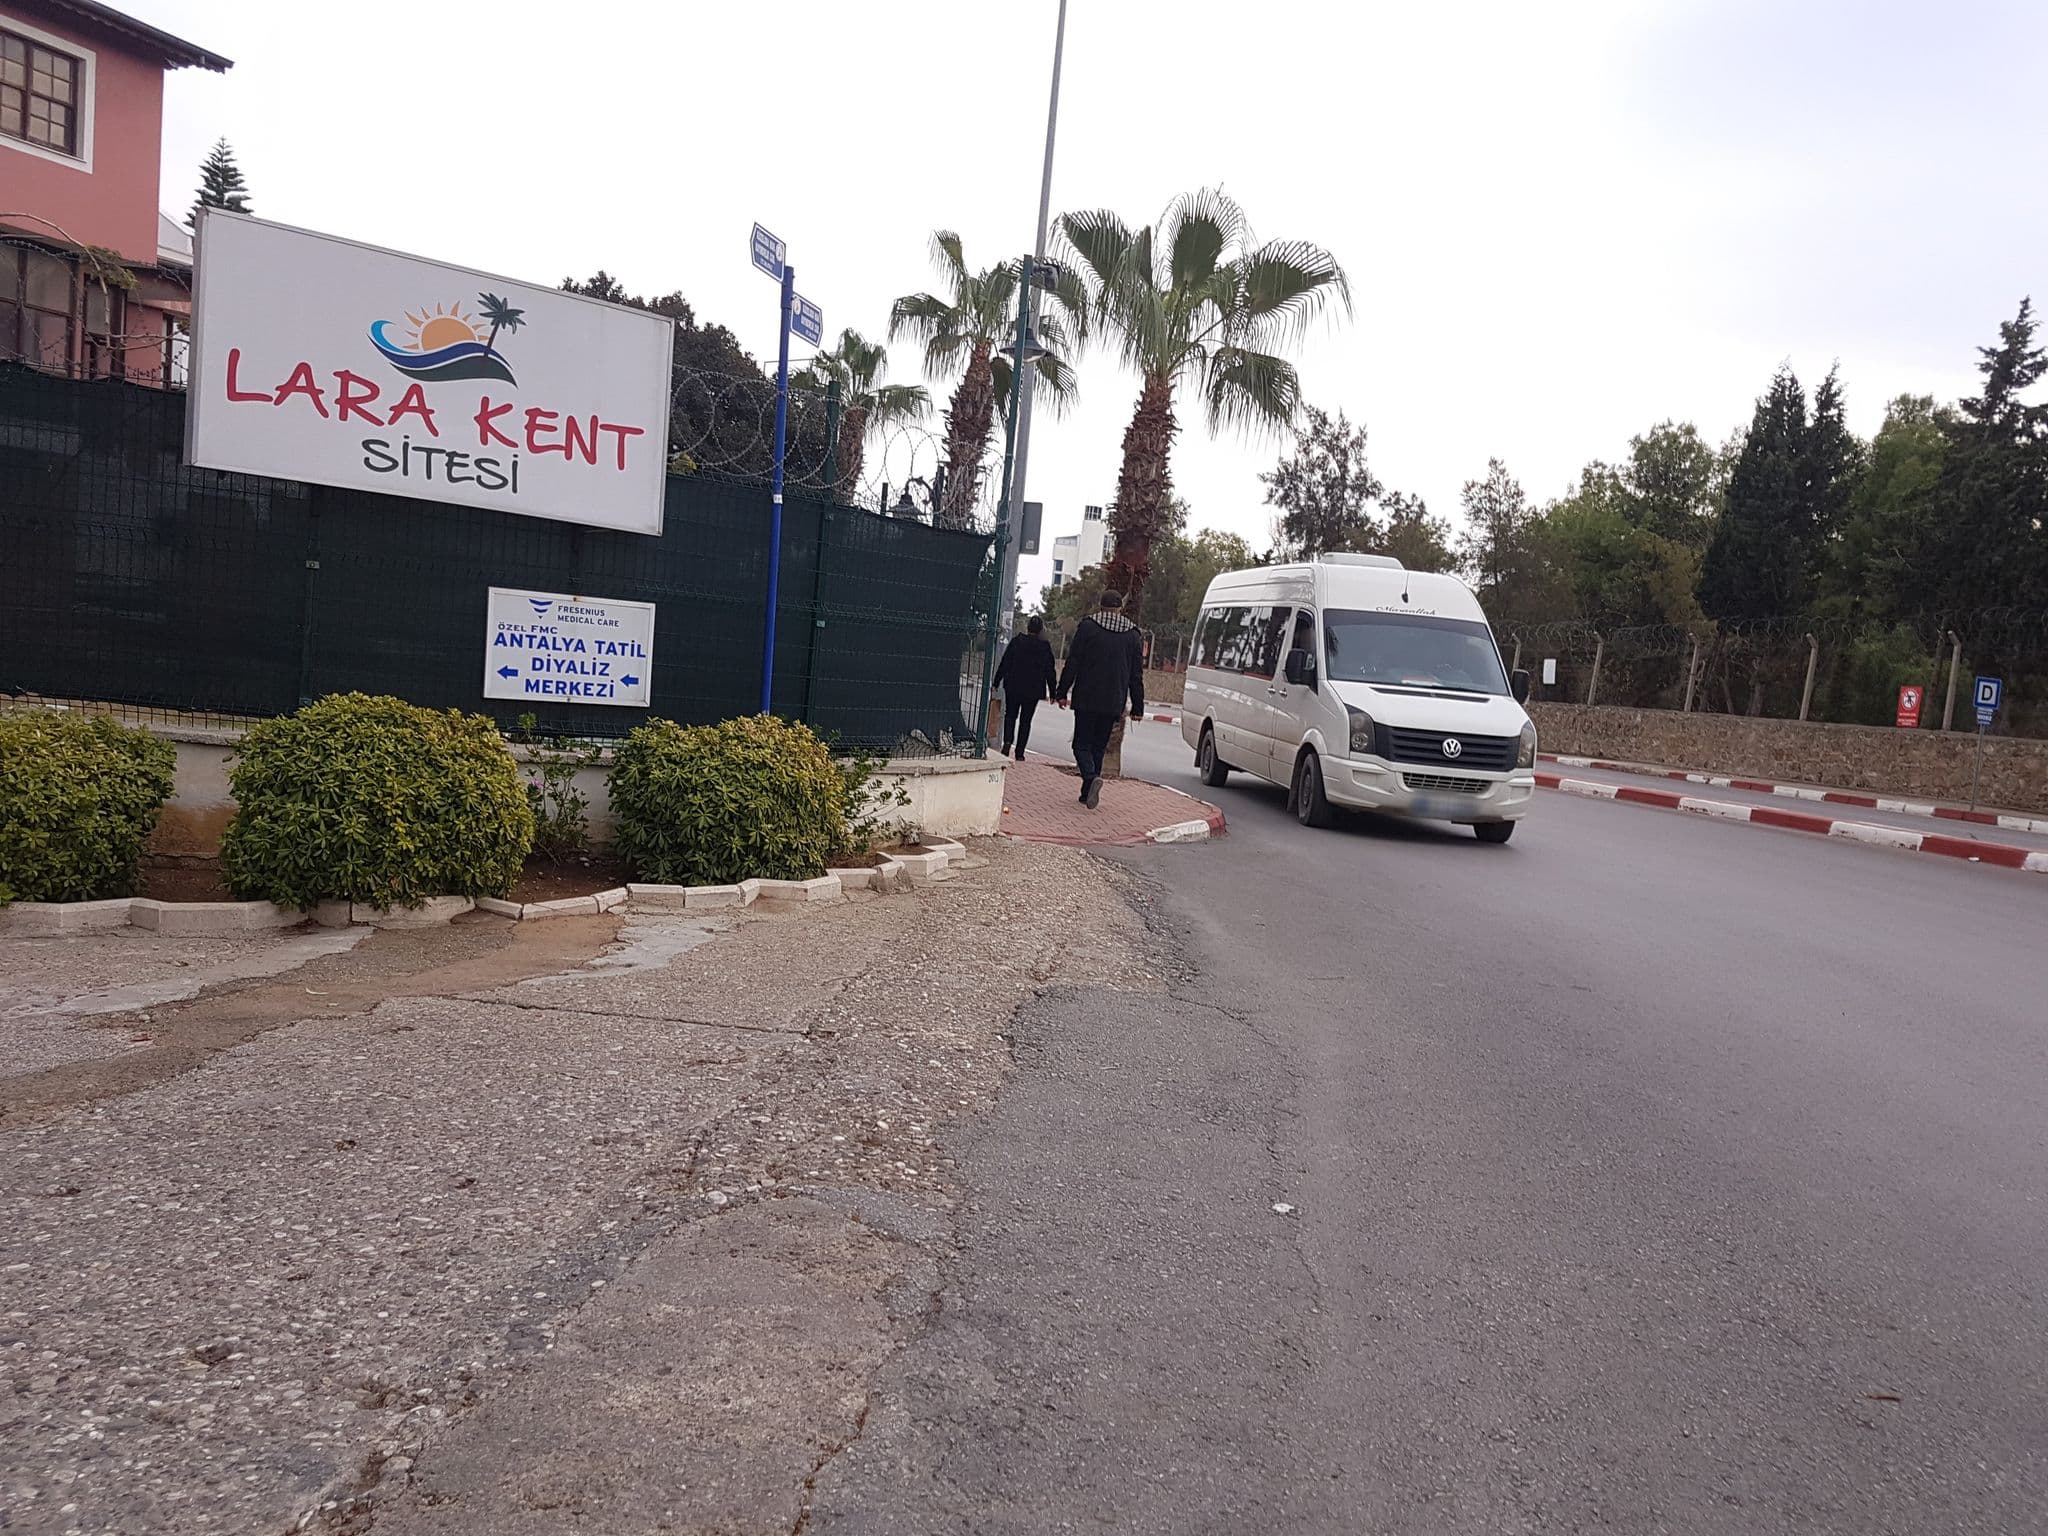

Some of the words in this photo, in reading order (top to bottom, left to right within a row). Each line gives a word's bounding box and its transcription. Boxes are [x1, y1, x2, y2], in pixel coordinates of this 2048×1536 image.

[226, 347, 439, 438] LARA
[474, 394, 646, 472] KENT
[361, 434, 520, 495] SİTESİ
[558, 605, 605, 617] FRESENIUS
[497, 621, 527, 633] ÖZEL
[530, 625, 558, 635] FMC
[558, 615, 595, 625] MEDICAL
[597, 619, 620, 628] CARE
[493, 632, 586, 654] ANTALYA
[594, 640, 646, 658] TATİL
[532, 654, 610, 677] DİYALİZ
[525, 679, 614, 698] MERKEZİ
[1981, 684, 1993, 701] D
